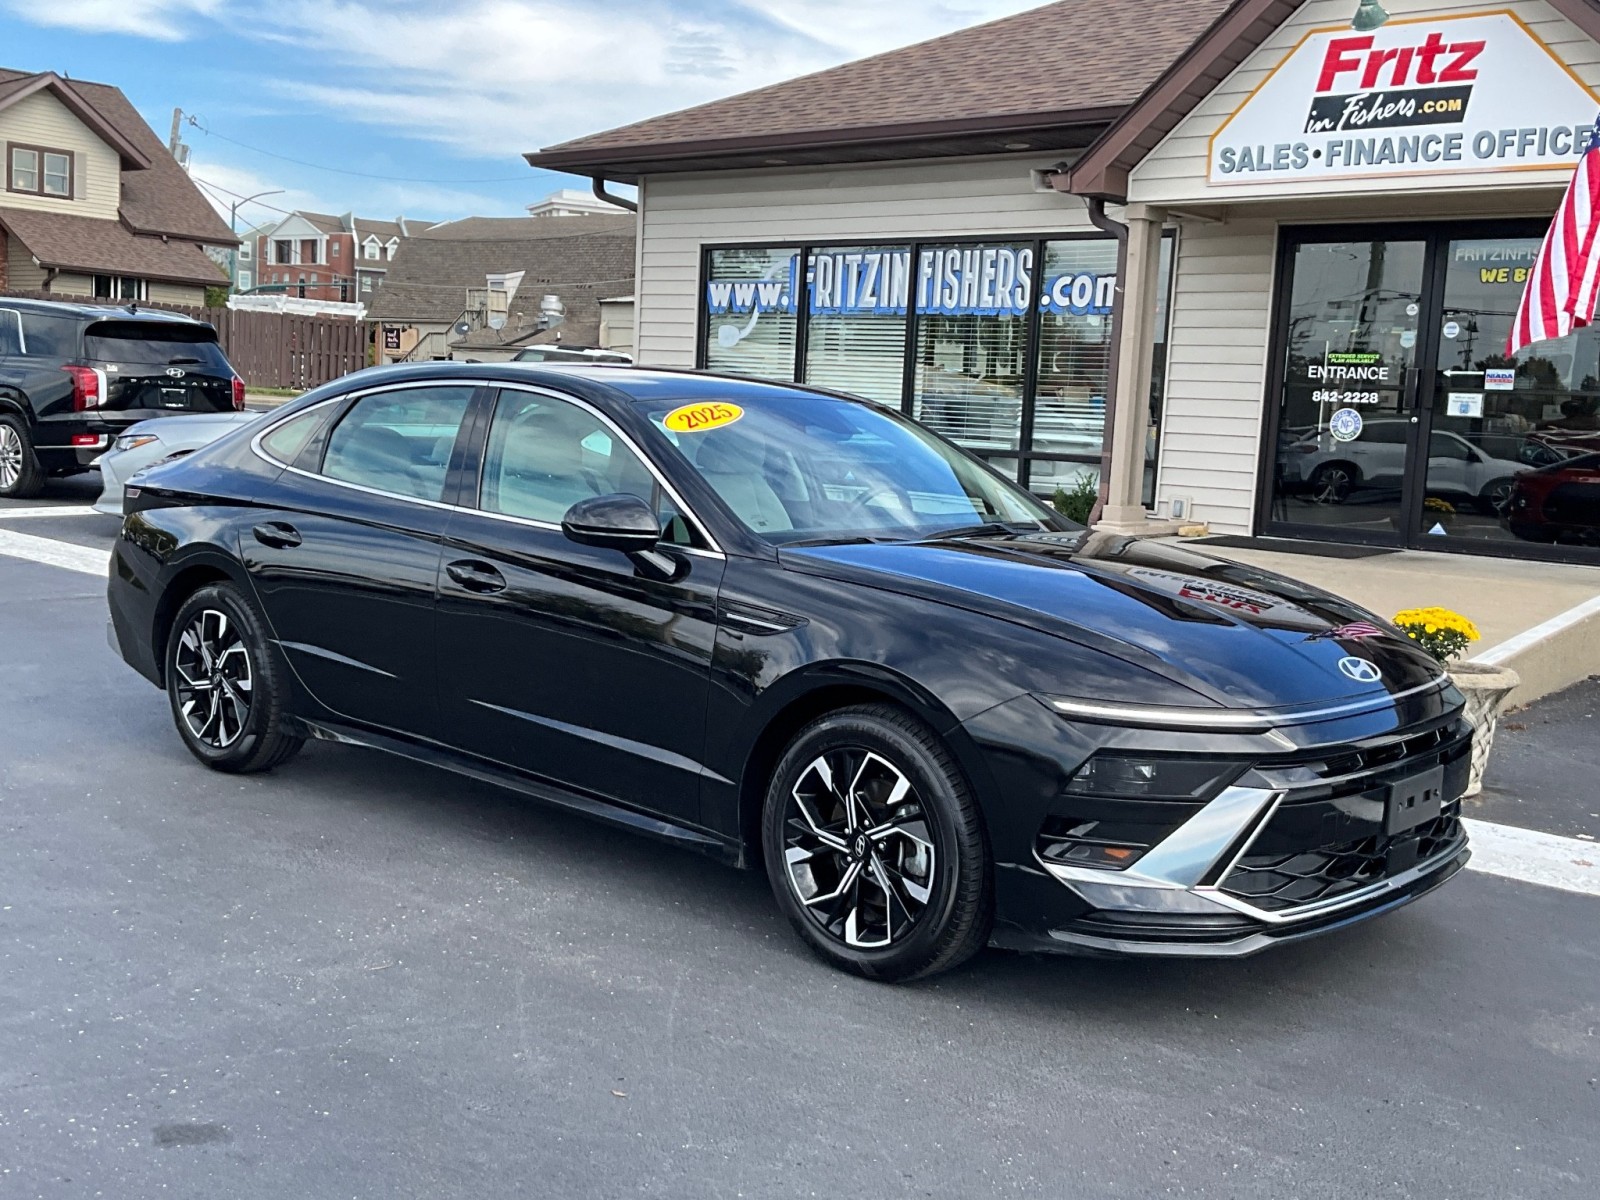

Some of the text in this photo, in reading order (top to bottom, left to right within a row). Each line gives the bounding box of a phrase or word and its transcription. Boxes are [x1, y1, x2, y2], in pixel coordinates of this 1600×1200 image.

[1315, 32, 1486, 93] Fritz
[1307, 110, 1334, 133] in
[1472, 125, 1595, 161] OFFICE
[1480, 267, 1510, 283] WE
[1308, 365, 1389, 380] ENTRANCE
[1312, 390, 1379, 404] 842-2228
[678, 404, 733, 428] 2025
